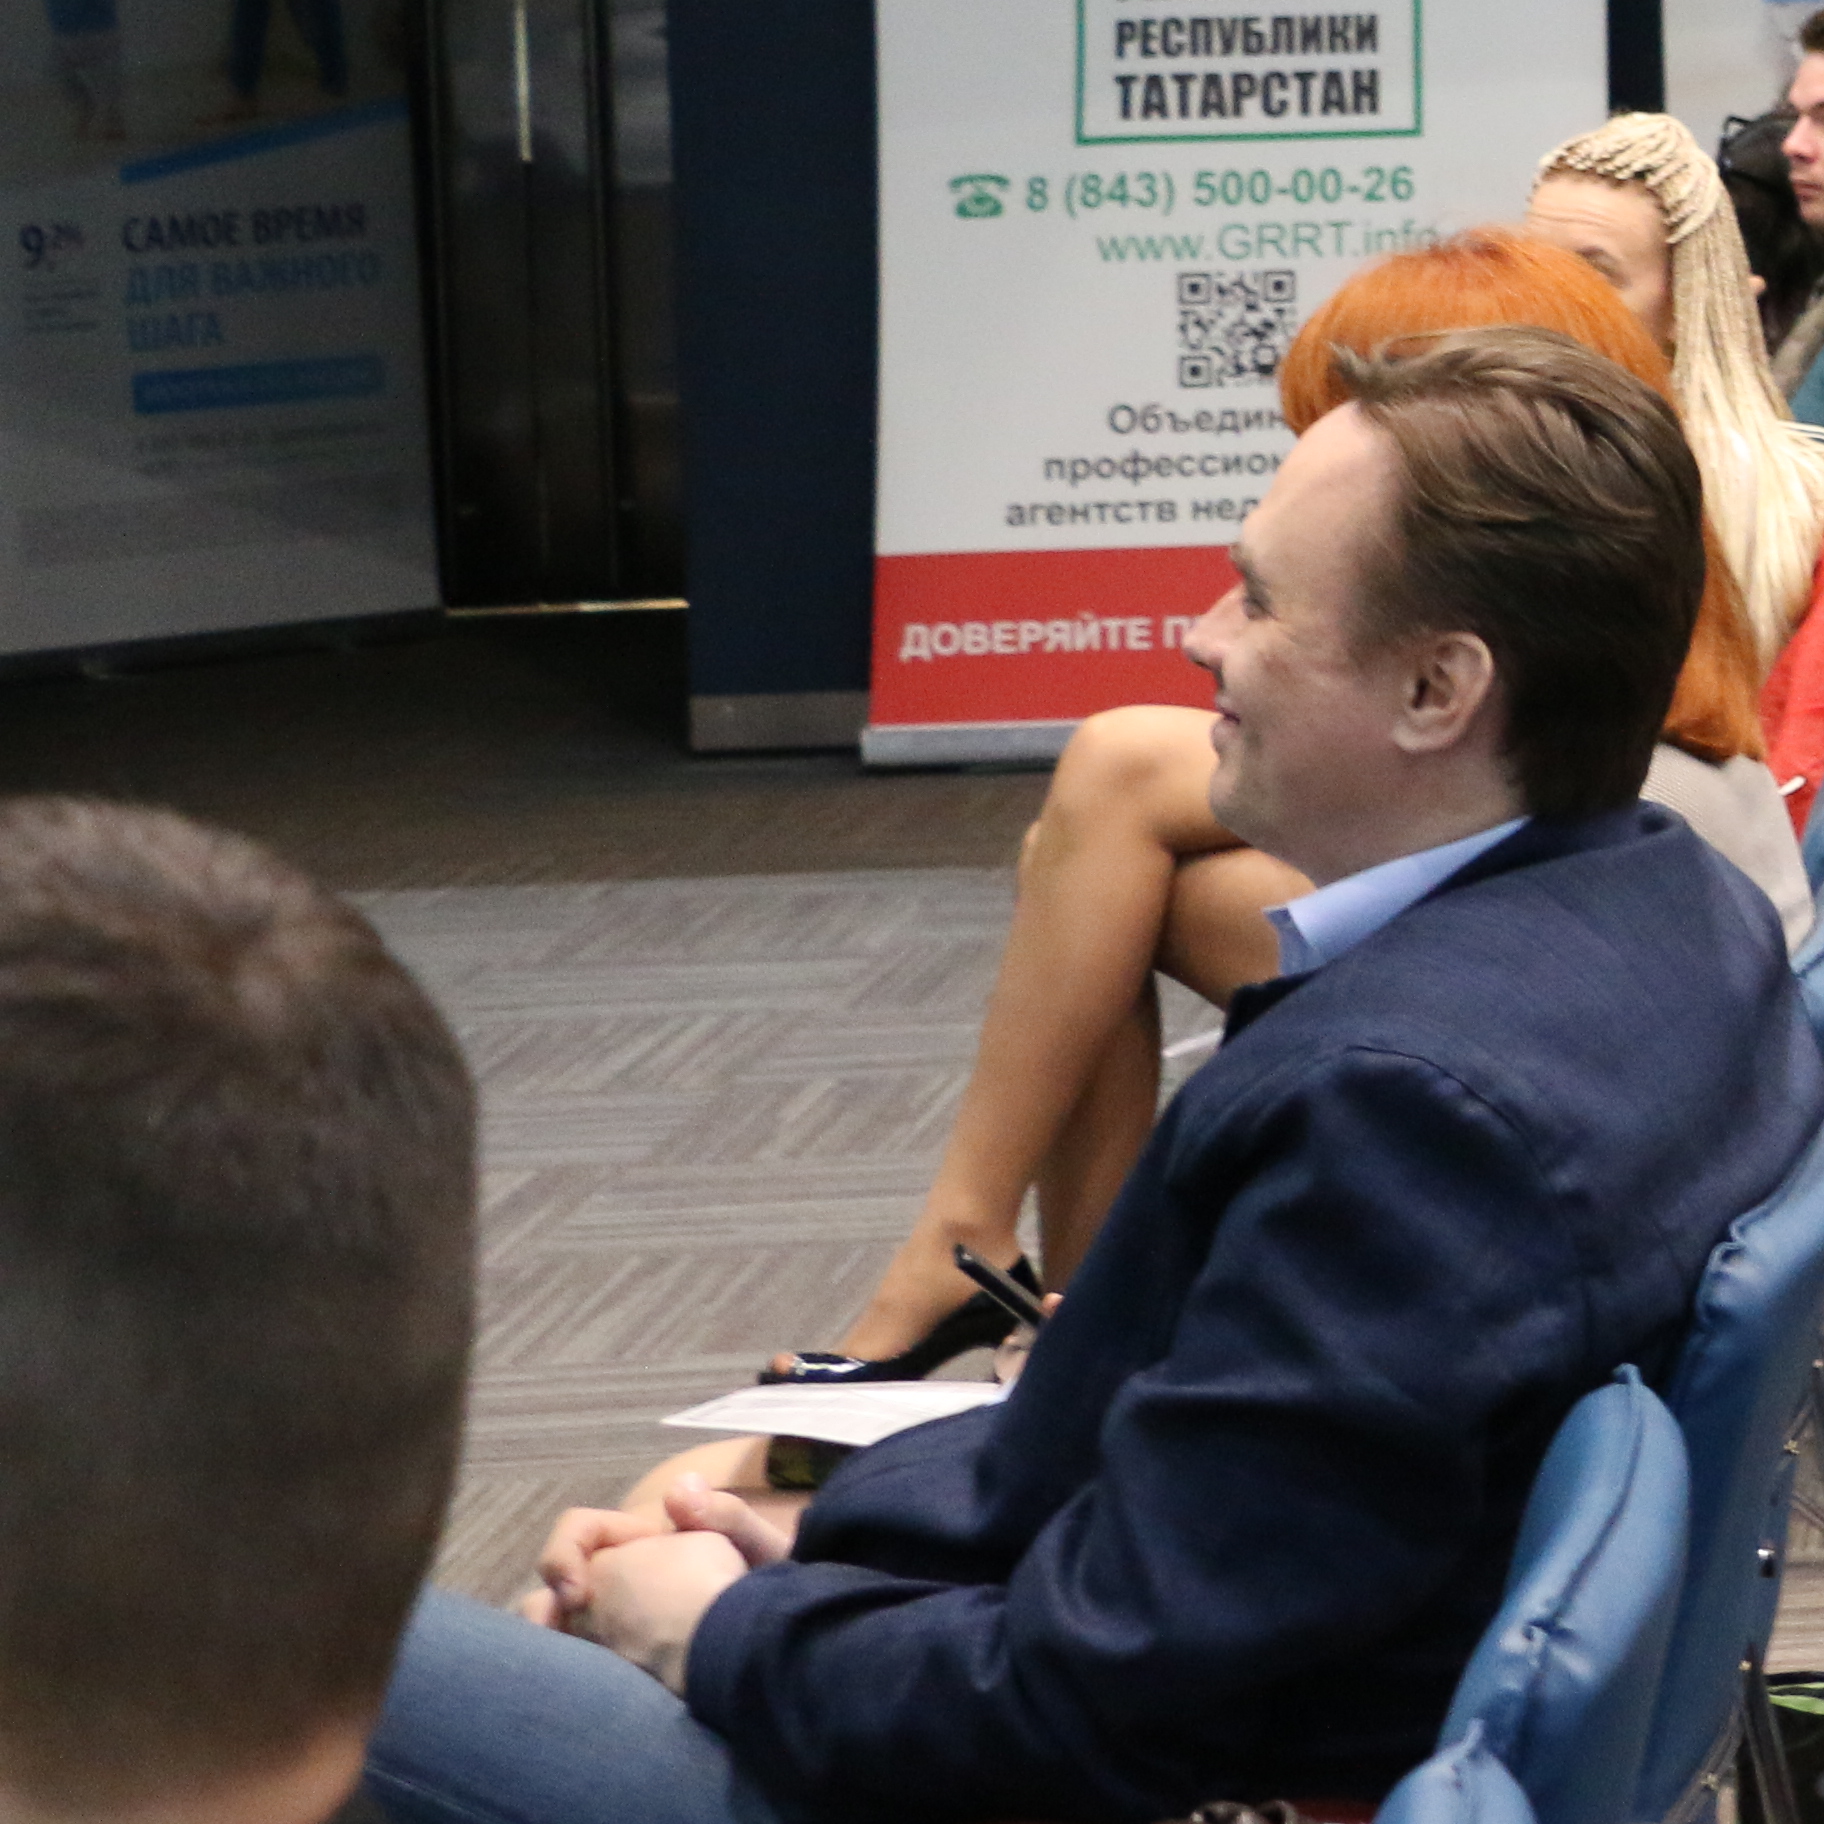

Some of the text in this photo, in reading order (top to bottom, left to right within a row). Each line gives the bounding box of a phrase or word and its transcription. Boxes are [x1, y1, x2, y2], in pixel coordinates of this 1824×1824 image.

[1115, 14, 1378, 59] РЕСПУБЛИКИ
[1115, 69, 1380, 120] ТАТАРСТАН
[1025, 166, 1415, 219] 8 (843) 500-00-26
[122, 204, 366, 252] САМОЕ ВРЕМЯ
[1006, 499, 1177, 527] агентств
[900, 613, 1153, 662] ДОВЕРЯЙТЕ
